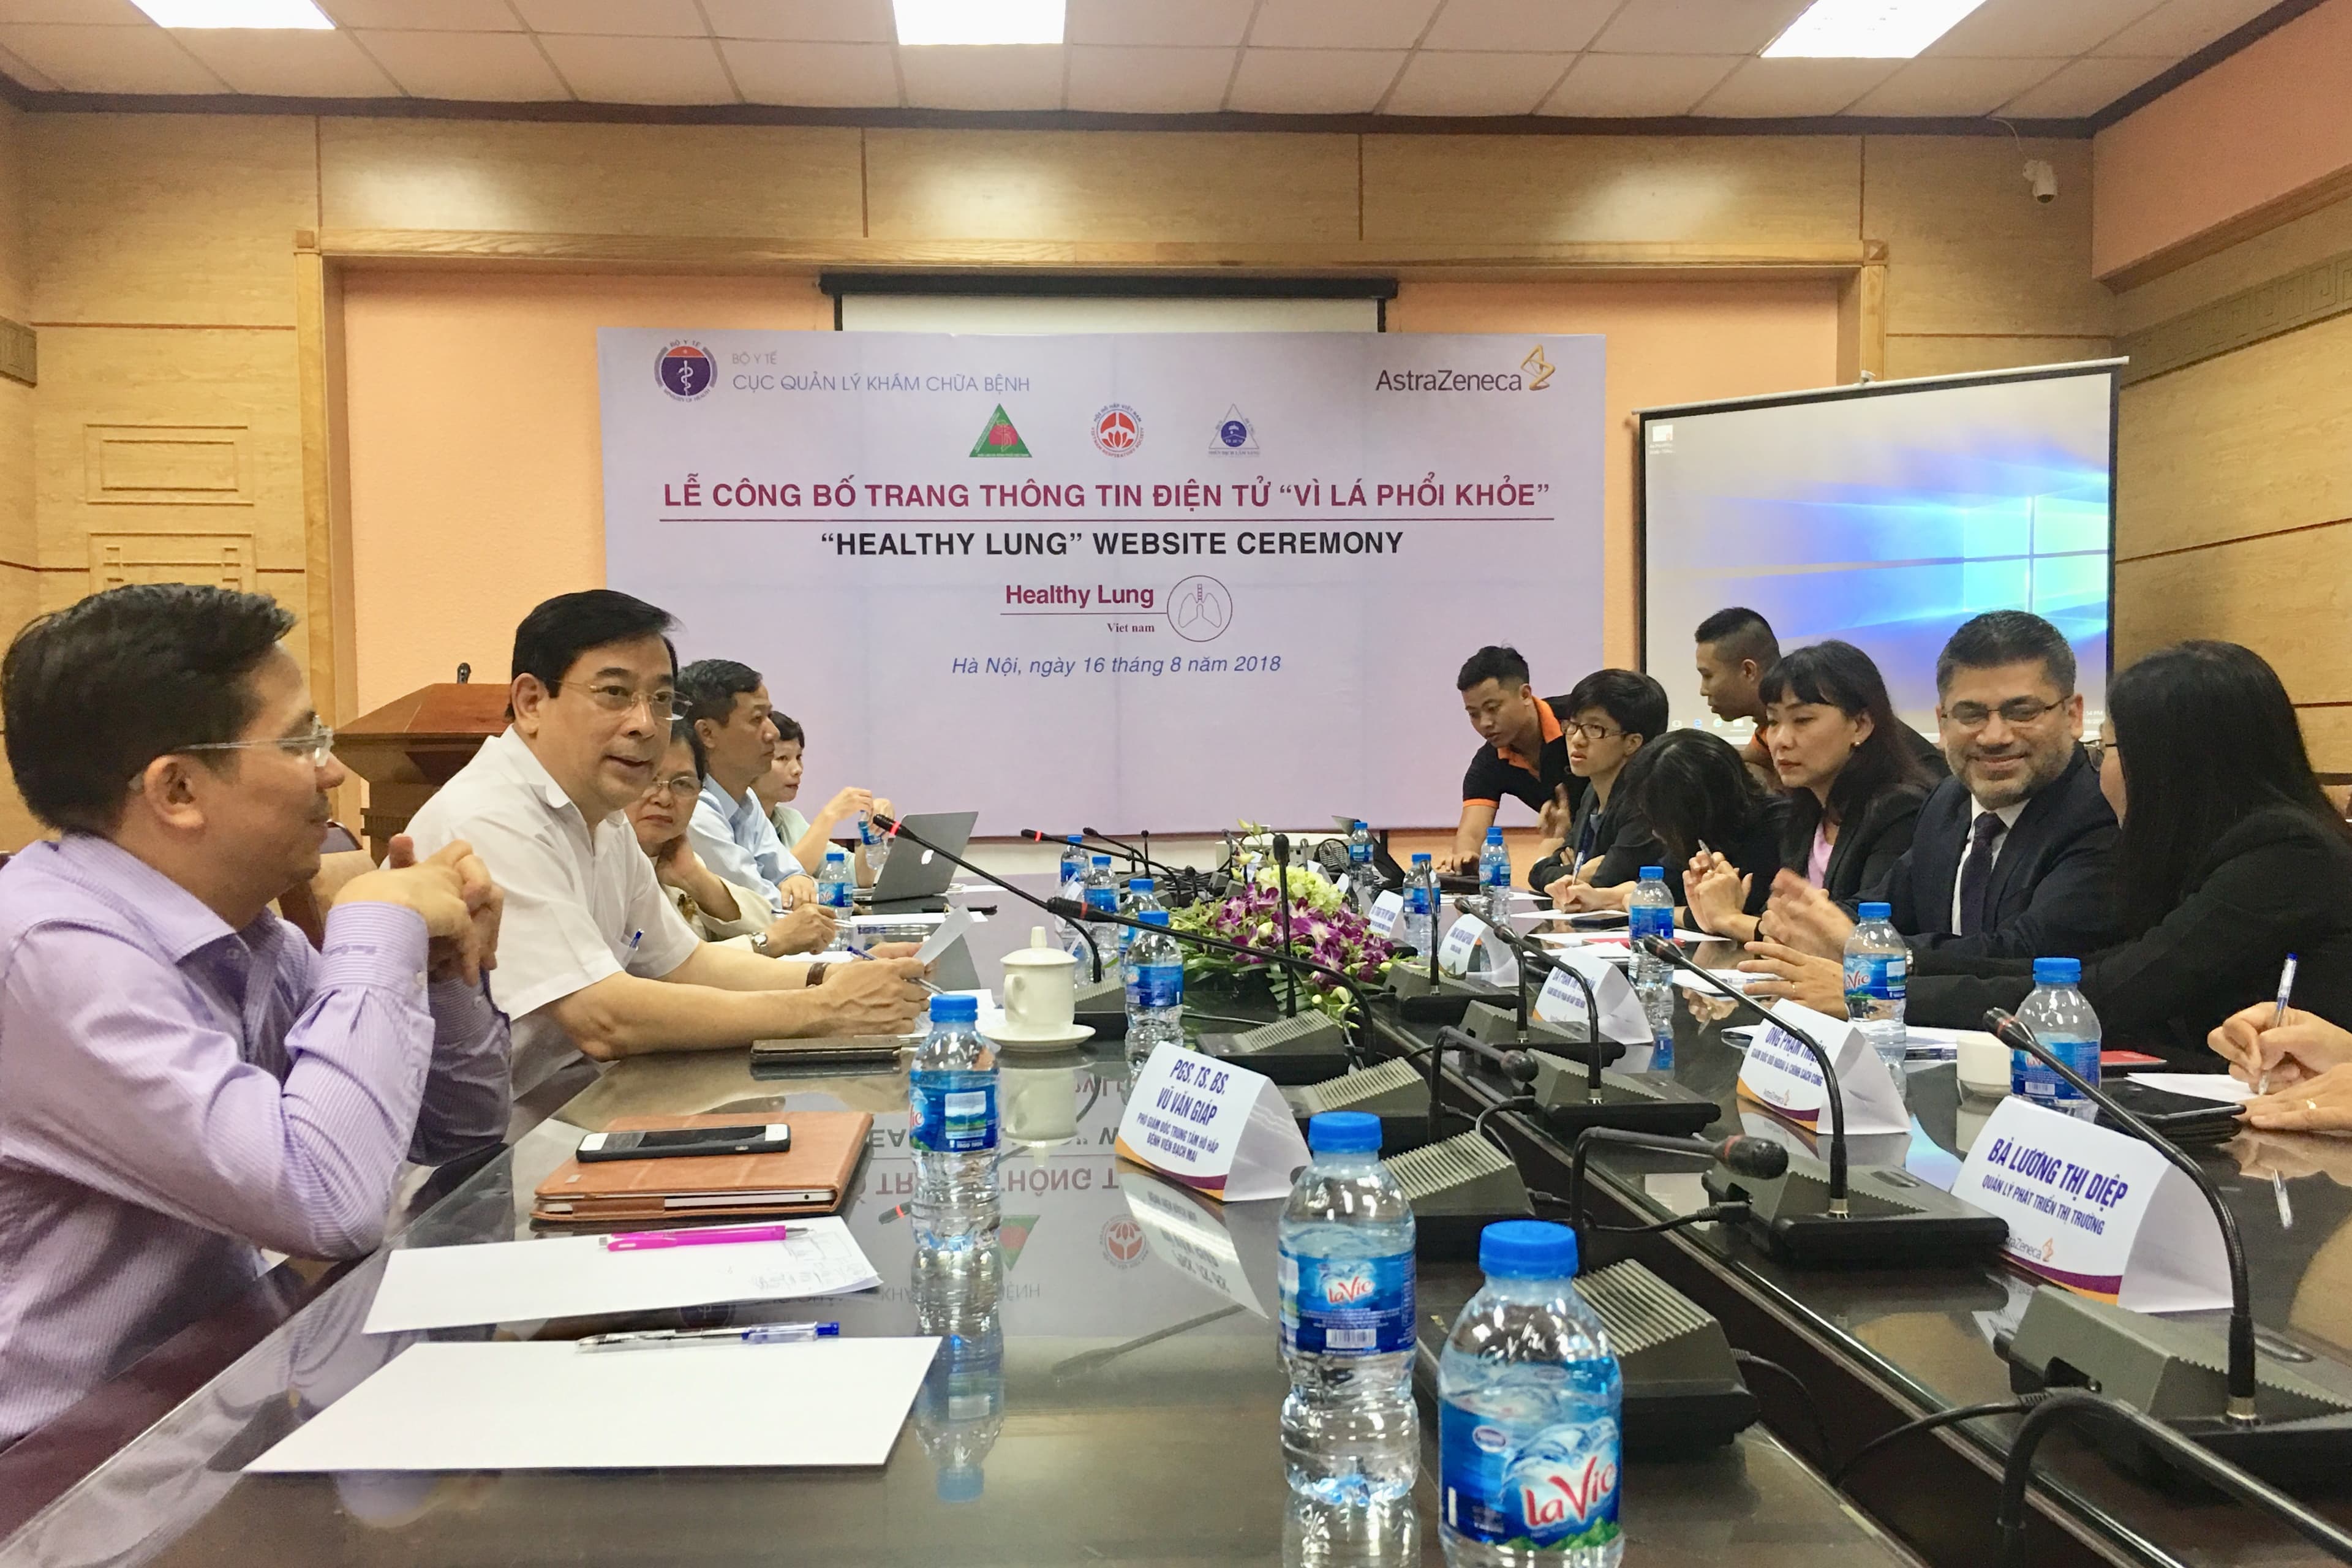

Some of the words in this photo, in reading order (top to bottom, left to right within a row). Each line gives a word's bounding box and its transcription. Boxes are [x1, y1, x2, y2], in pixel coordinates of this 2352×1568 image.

[732, 351, 751, 366] BỘ
[754, 353, 761, 364] Y
[764, 350, 777, 365] TẾ
[732, 374, 775, 394] CỤC
[780, 371, 836, 391] QUẢN
[842, 372, 862, 391] LÝ
[867, 372, 920, 391] KHÁM
[925, 372, 979, 392] CHỮA
[984, 373, 1030, 396] BỆNH
[1375, 369, 1522, 392] AstraZeneca
[665, 472, 703, 507] LỄ
[712, 477, 802, 508] CÔNG
[813, 474, 857, 508] BỐ
[864, 483, 970, 508] TRANG
[979, 478, 1085, 508] THÔNG
[1095, 484, 1142, 507] TIN
[1152, 478, 1222, 513] ĐIỆN
[1231, 475, 1272, 508] TỬ
[1279, 478, 1320, 507] “VÌ
[1330, 477, 1368, 507] LÁ
[1377, 471, 1445, 507] PHỔI
[1455, 474, 1550, 507] KHỎE”
[821, 532, 976, 556] “HEALTHY
[986, 532, 1082, 556] LUNG”
[1092, 532, 1227, 556] WEBSITE
[1237, 531, 1404, 555] CEREMONY
[1006, 584, 1091, 609] Healthy
[1098, 584, 1154, 609] Lung
[1106, 622, 1129, 633] Viet
[1131, 624, 1155, 633] nam
[952, 657, 979, 674] Hà
[985, 657, 1022, 677] Nội,
[1029, 656, 1076, 678] ngày
[1084, 657, 1106, 673] 16
[1112, 655, 1165, 677] tháng
[1169, 656, 1182, 673] 8
[1188, 656, 1229, 673] năm
[1233, 655, 1282, 673] 2018
[1845, 970, 1869, 989] Vie
[1169, 1058, 1195, 1084] PGS.
[1193, 1066, 1211, 1089] TS.
[1209, 1071, 1229, 1095] BS.
[1156, 1085, 1174, 1110] VŨ
[1170, 1090, 1194, 1118] VĂN
[1190, 1099, 1218, 1126] GIÁP
[1170, 1125, 1188, 1142] TRUNG
[1147, 1131, 1161, 1148] BỆNH
[1171, 1142, 1187, 1158] BẠCH
[1185, 1148, 1199, 1163] MAI
[2008, 1145, 2063, 1185] LƯƠNG
[2059, 1163, 2090, 1201] THỊ
[2084, 1173, 2129, 1212] DIỆP
[2011, 1187, 2035, 1206] PHÁT
[2032, 1194, 2058, 1216] TRIỂN
[2056, 1203, 2072, 1224] THỊ
[2070, 1209, 2106, 1236] TRƯỜNG
